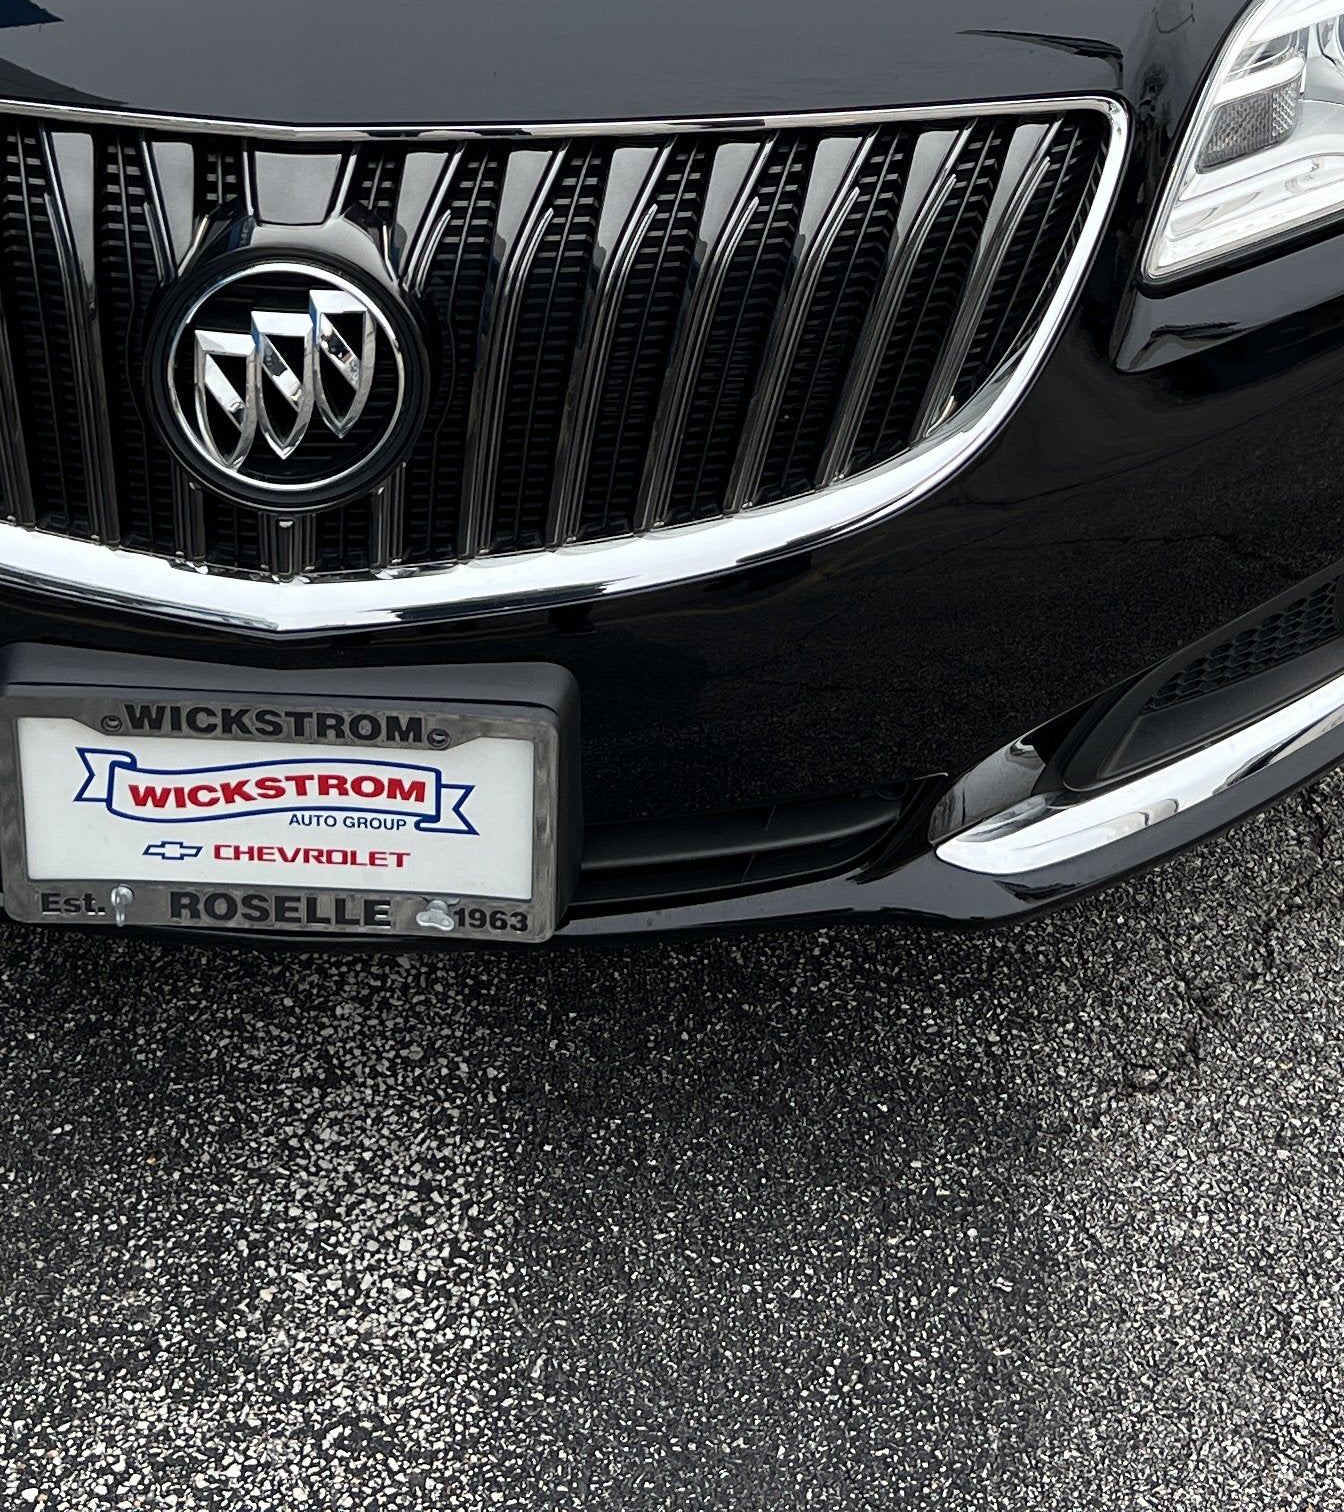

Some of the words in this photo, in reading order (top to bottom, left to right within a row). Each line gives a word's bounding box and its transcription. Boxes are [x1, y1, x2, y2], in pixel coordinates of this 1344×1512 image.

[124, 703, 422, 744] WICKSTROM
[128, 774, 426, 808] WICKSTROM
[289, 813, 337, 828] AUTO
[343, 816, 407, 830] GROUP
[213, 844, 411, 868] CHEVROLET
[41, 892, 106, 915] Est.
[170, 891, 391, 928] ROSELLE
[454, 907, 529, 932] 1963
